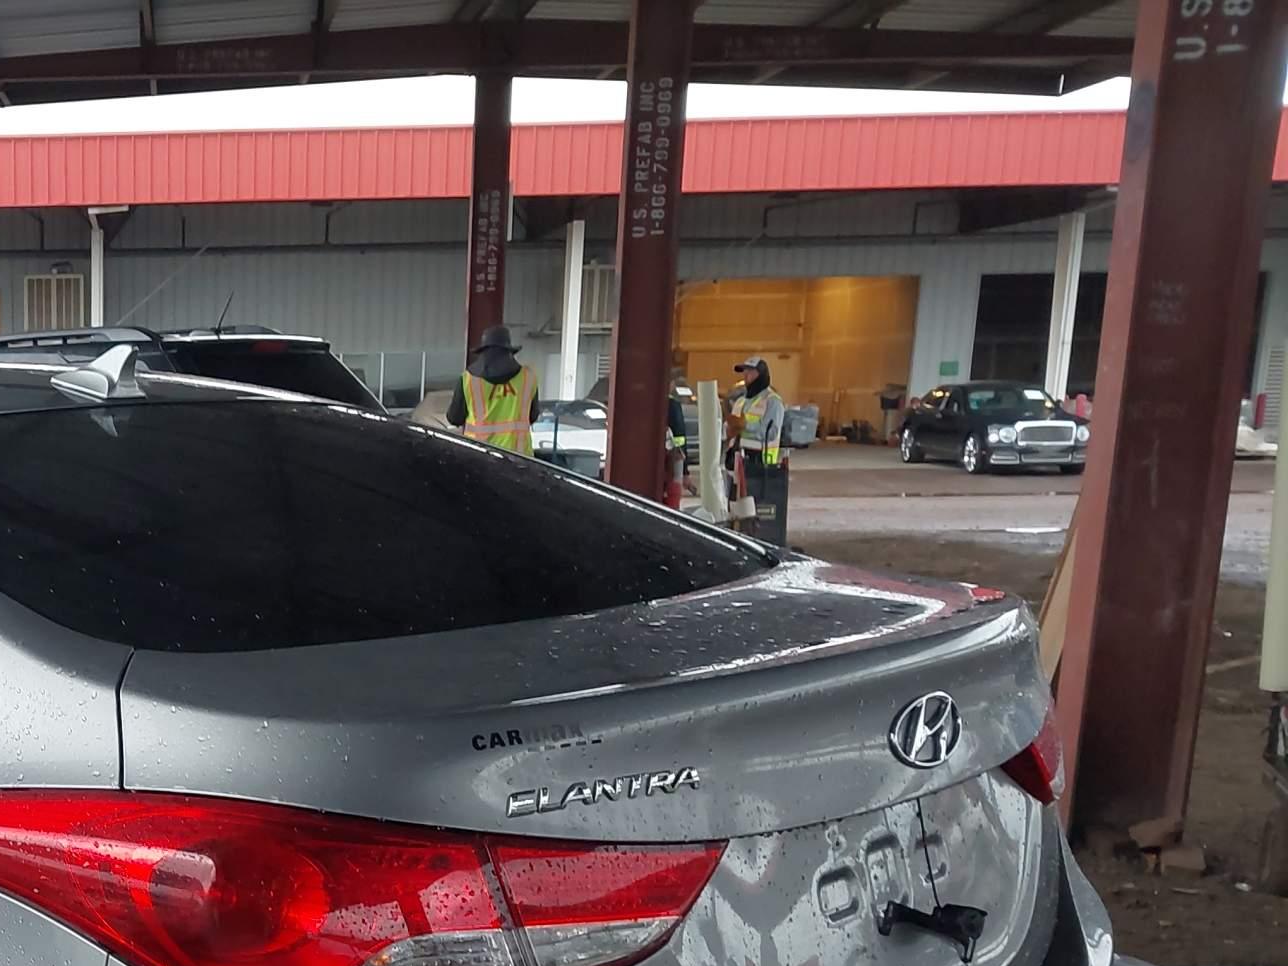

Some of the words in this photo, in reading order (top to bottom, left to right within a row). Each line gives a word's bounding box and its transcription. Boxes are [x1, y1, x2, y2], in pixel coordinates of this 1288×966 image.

[640, 81, 655, 112] INC
[634, 121, 653, 193] PREFAB
[505, 766, 701, 818] ELANTRA
